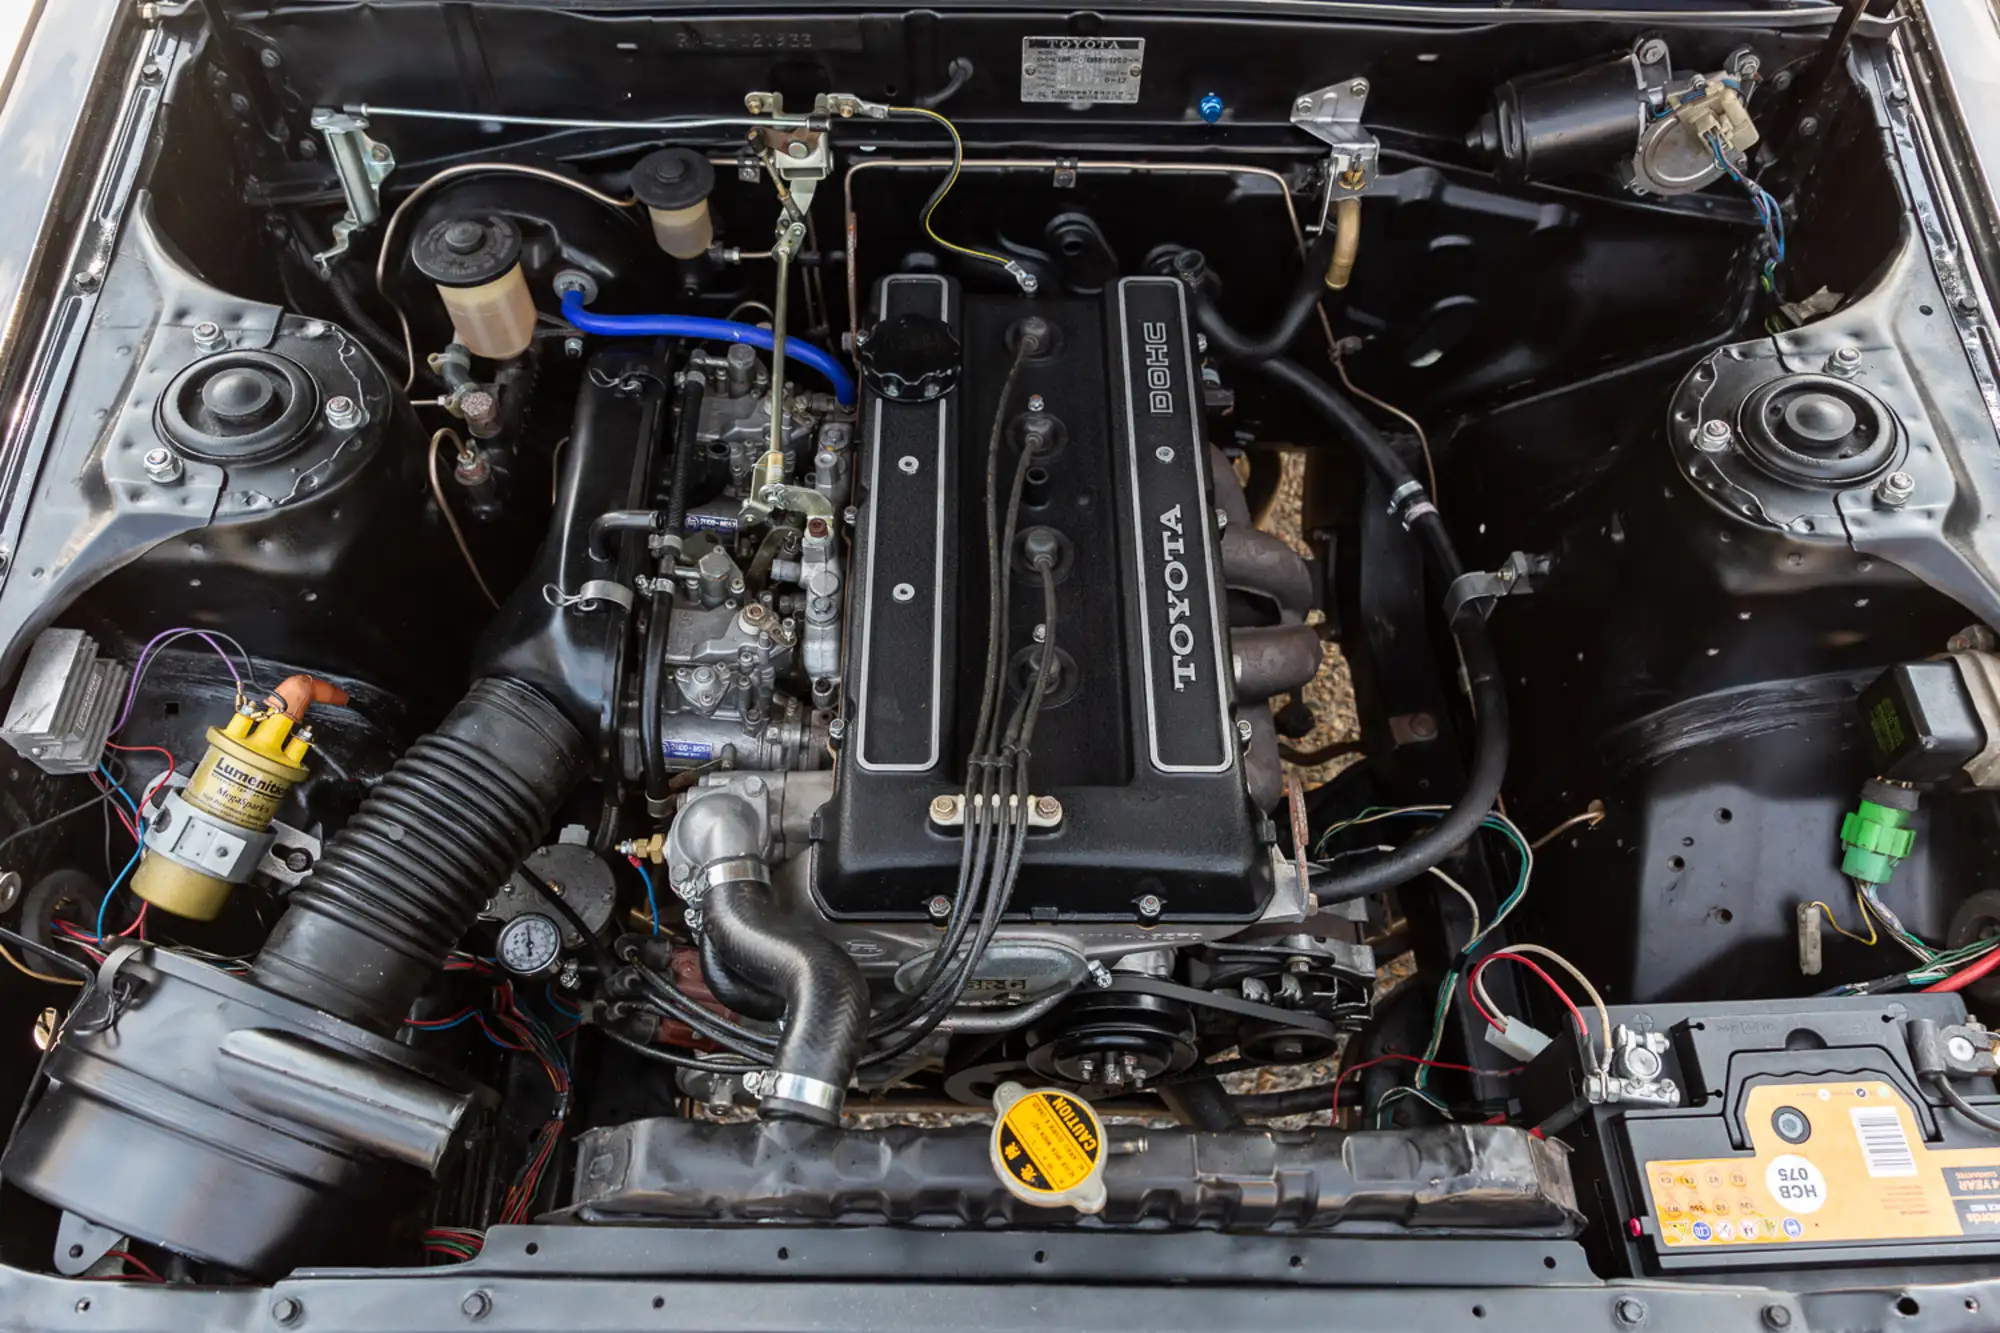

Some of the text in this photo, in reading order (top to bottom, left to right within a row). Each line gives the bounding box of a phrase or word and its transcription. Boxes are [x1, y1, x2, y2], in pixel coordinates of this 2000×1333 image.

[1046, 40, 1120, 49] TOYOTA
[1143, 322, 1173, 414] DOHC
[1159, 504, 1196, 692] TOYOTA
[215, 756, 286, 797] Lumenitio
[1052, 1096, 1097, 1151] CAUTION
[1778, 1167, 1808, 1182] 075
[1958, 1179, 1992, 1191] YEAR
[1778, 1184, 1818, 1199] HCB
